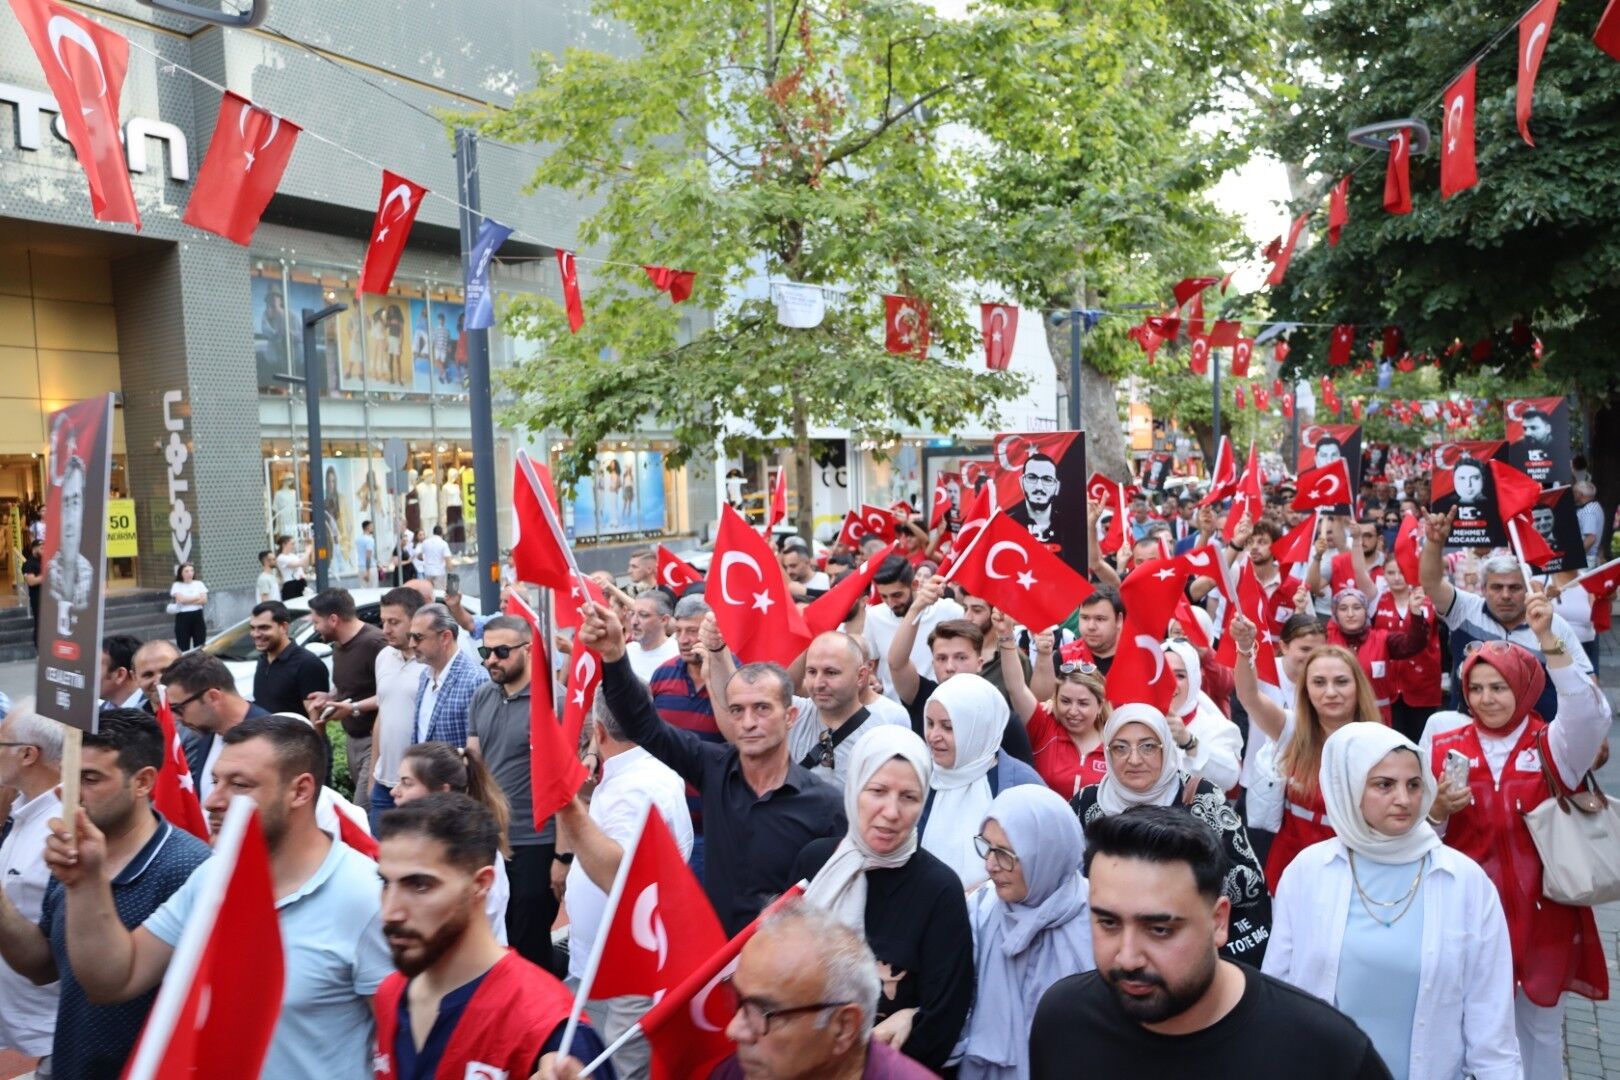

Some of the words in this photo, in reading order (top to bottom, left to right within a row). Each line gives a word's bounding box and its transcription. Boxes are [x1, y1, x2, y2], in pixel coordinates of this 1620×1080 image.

[110, 515, 129, 529] 50
[1233, 917, 1252, 933] THE
[1226, 935, 1255, 955] TOTE
[1251, 925, 1269, 944] BAG
